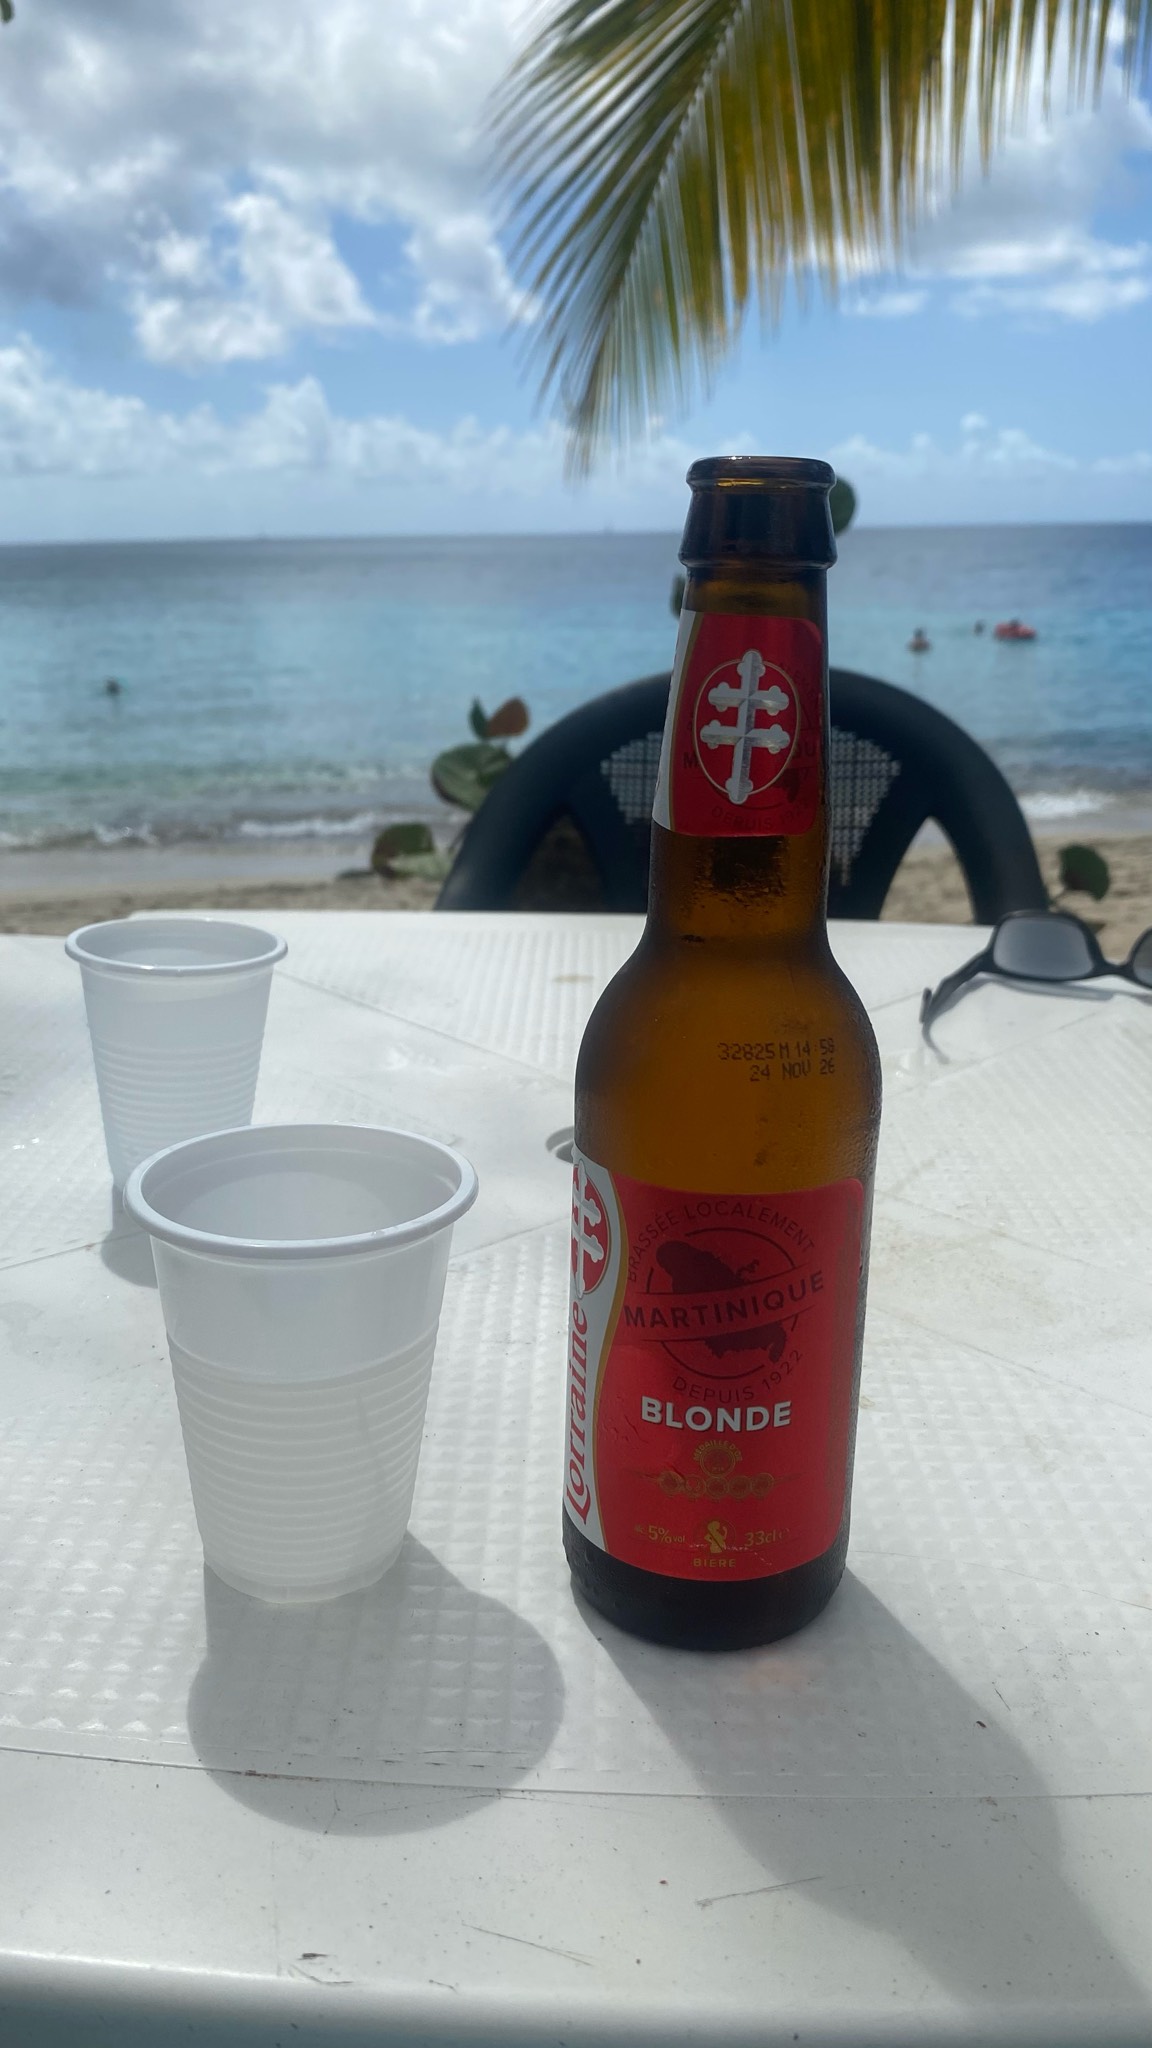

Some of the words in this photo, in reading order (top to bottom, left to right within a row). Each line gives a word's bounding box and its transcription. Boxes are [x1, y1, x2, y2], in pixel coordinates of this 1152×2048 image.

[749, 1064, 771, 1082] 24
[782, 1059, 812, 1081] NOV
[819, 1057, 836, 1076] 26
[627, 1209, 680, 1283] BRASSÉE
[683, 1201, 816, 1253] LOCALEMENT
[623, 1270, 825, 1329] MARTINIQUE
[671, 1376, 755, 1404] DEPUIS
[761, 1350, 803, 1392] 1922
[566, 1300, 592, 1526] Lorraine
[641, 1395, 793, 1433] BLONDE
